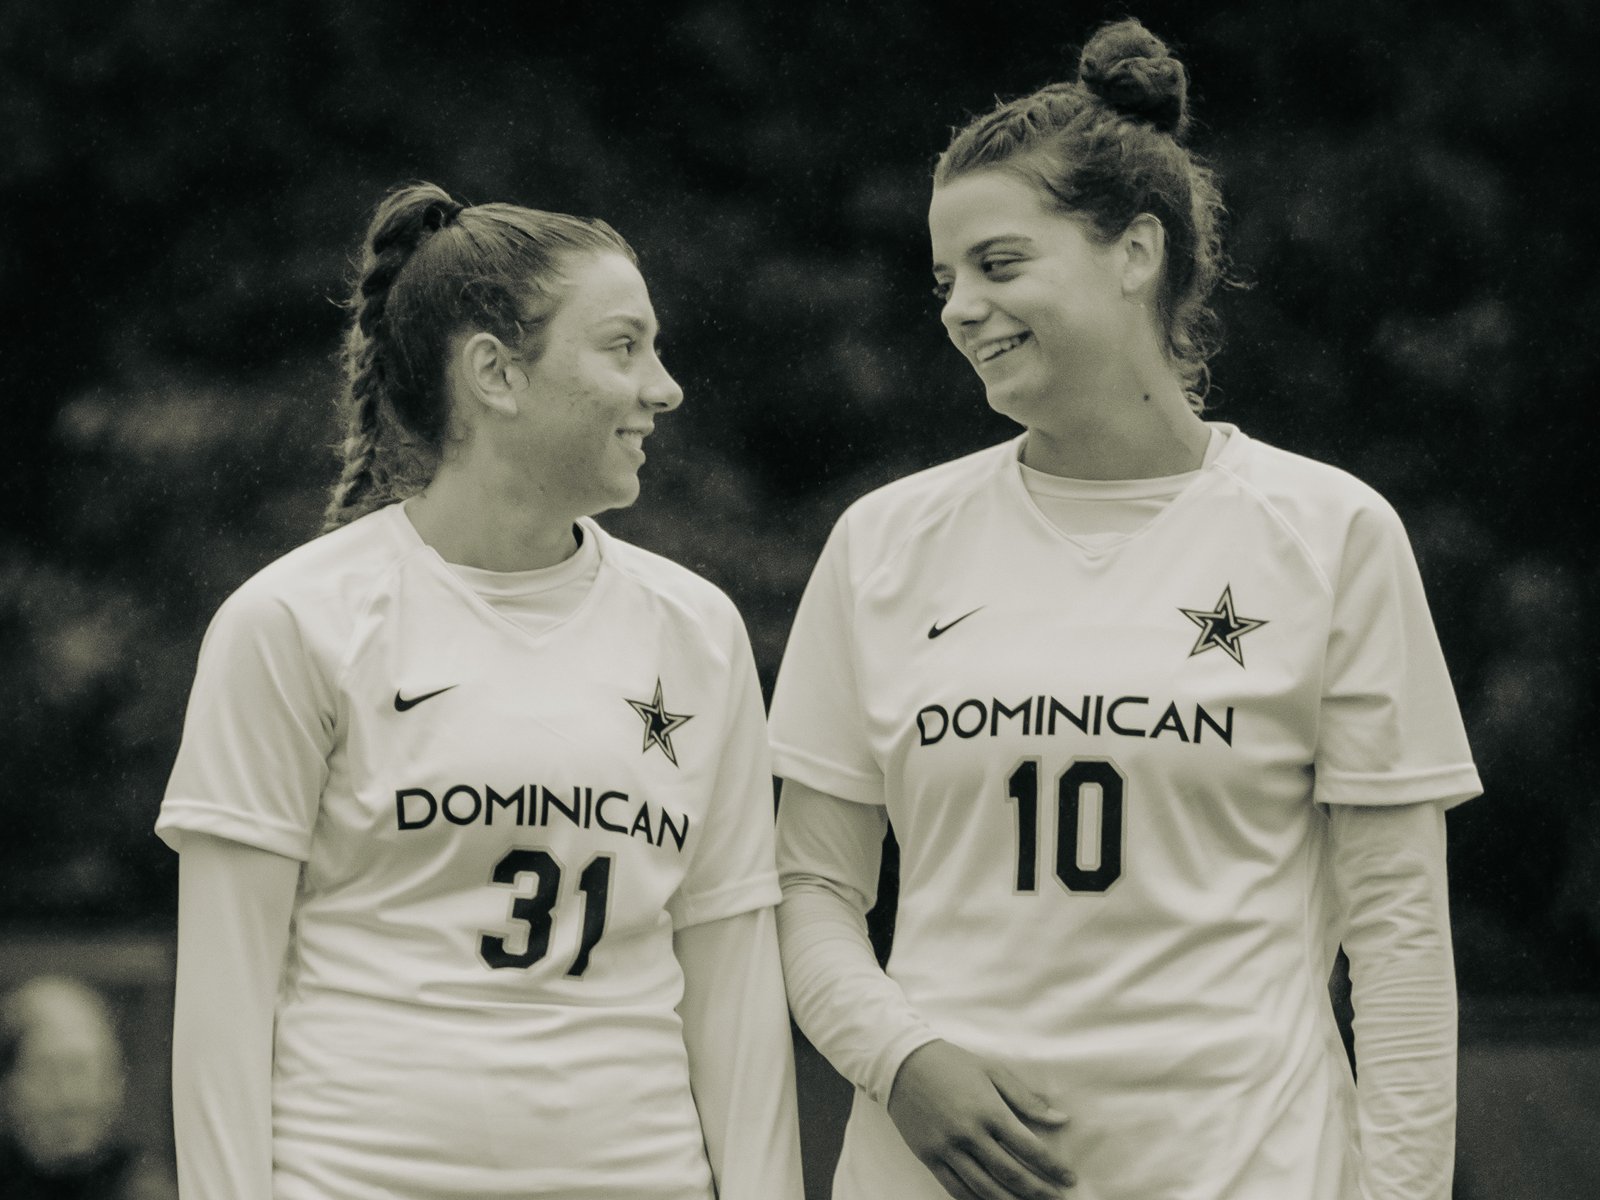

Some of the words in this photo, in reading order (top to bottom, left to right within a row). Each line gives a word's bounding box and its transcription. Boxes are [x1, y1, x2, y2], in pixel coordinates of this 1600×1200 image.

[915, 695, 1235, 747] DOMINICAN
[395, 784, 690, 853] DOMINICAN
[1006, 758, 1126, 895] 10
[478, 847, 614, 978] 31
